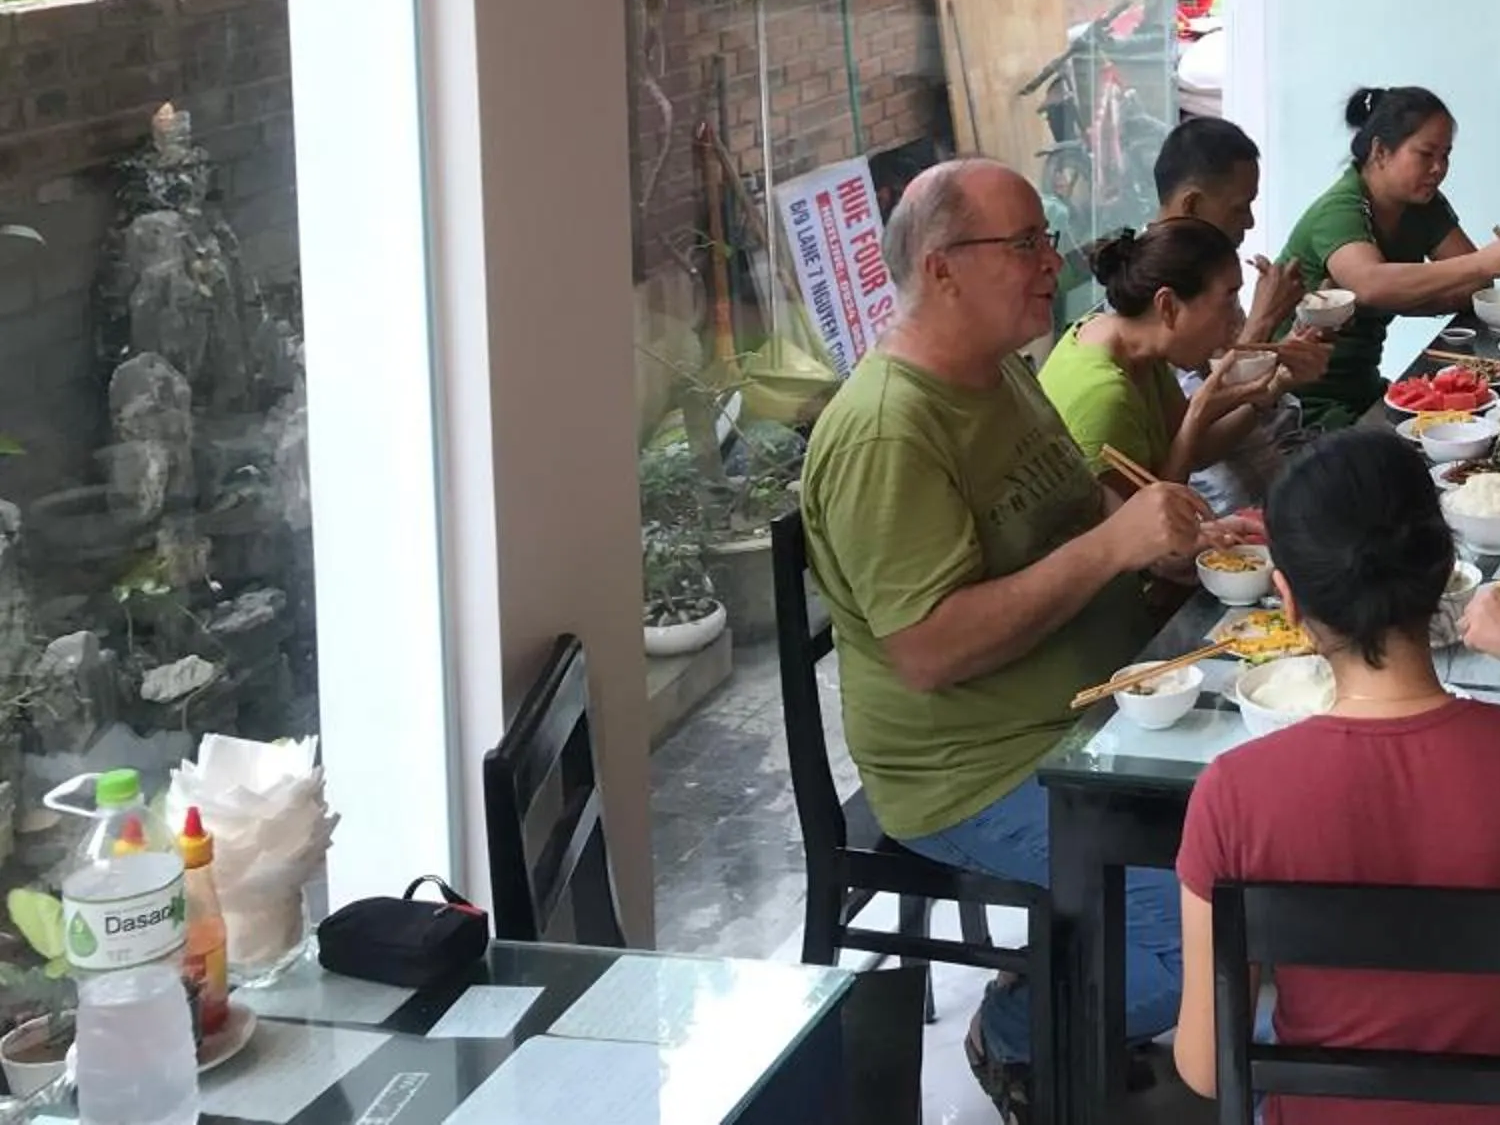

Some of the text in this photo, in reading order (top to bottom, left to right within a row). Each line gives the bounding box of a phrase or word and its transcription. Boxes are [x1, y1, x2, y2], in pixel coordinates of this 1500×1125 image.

[837, 176, 872, 229] HUE
[797, 228, 823, 268] LANE
[808, 266, 825, 280] 7
[850, 227, 888, 297] FOUR
[810, 279, 841, 343] NGUYEN
